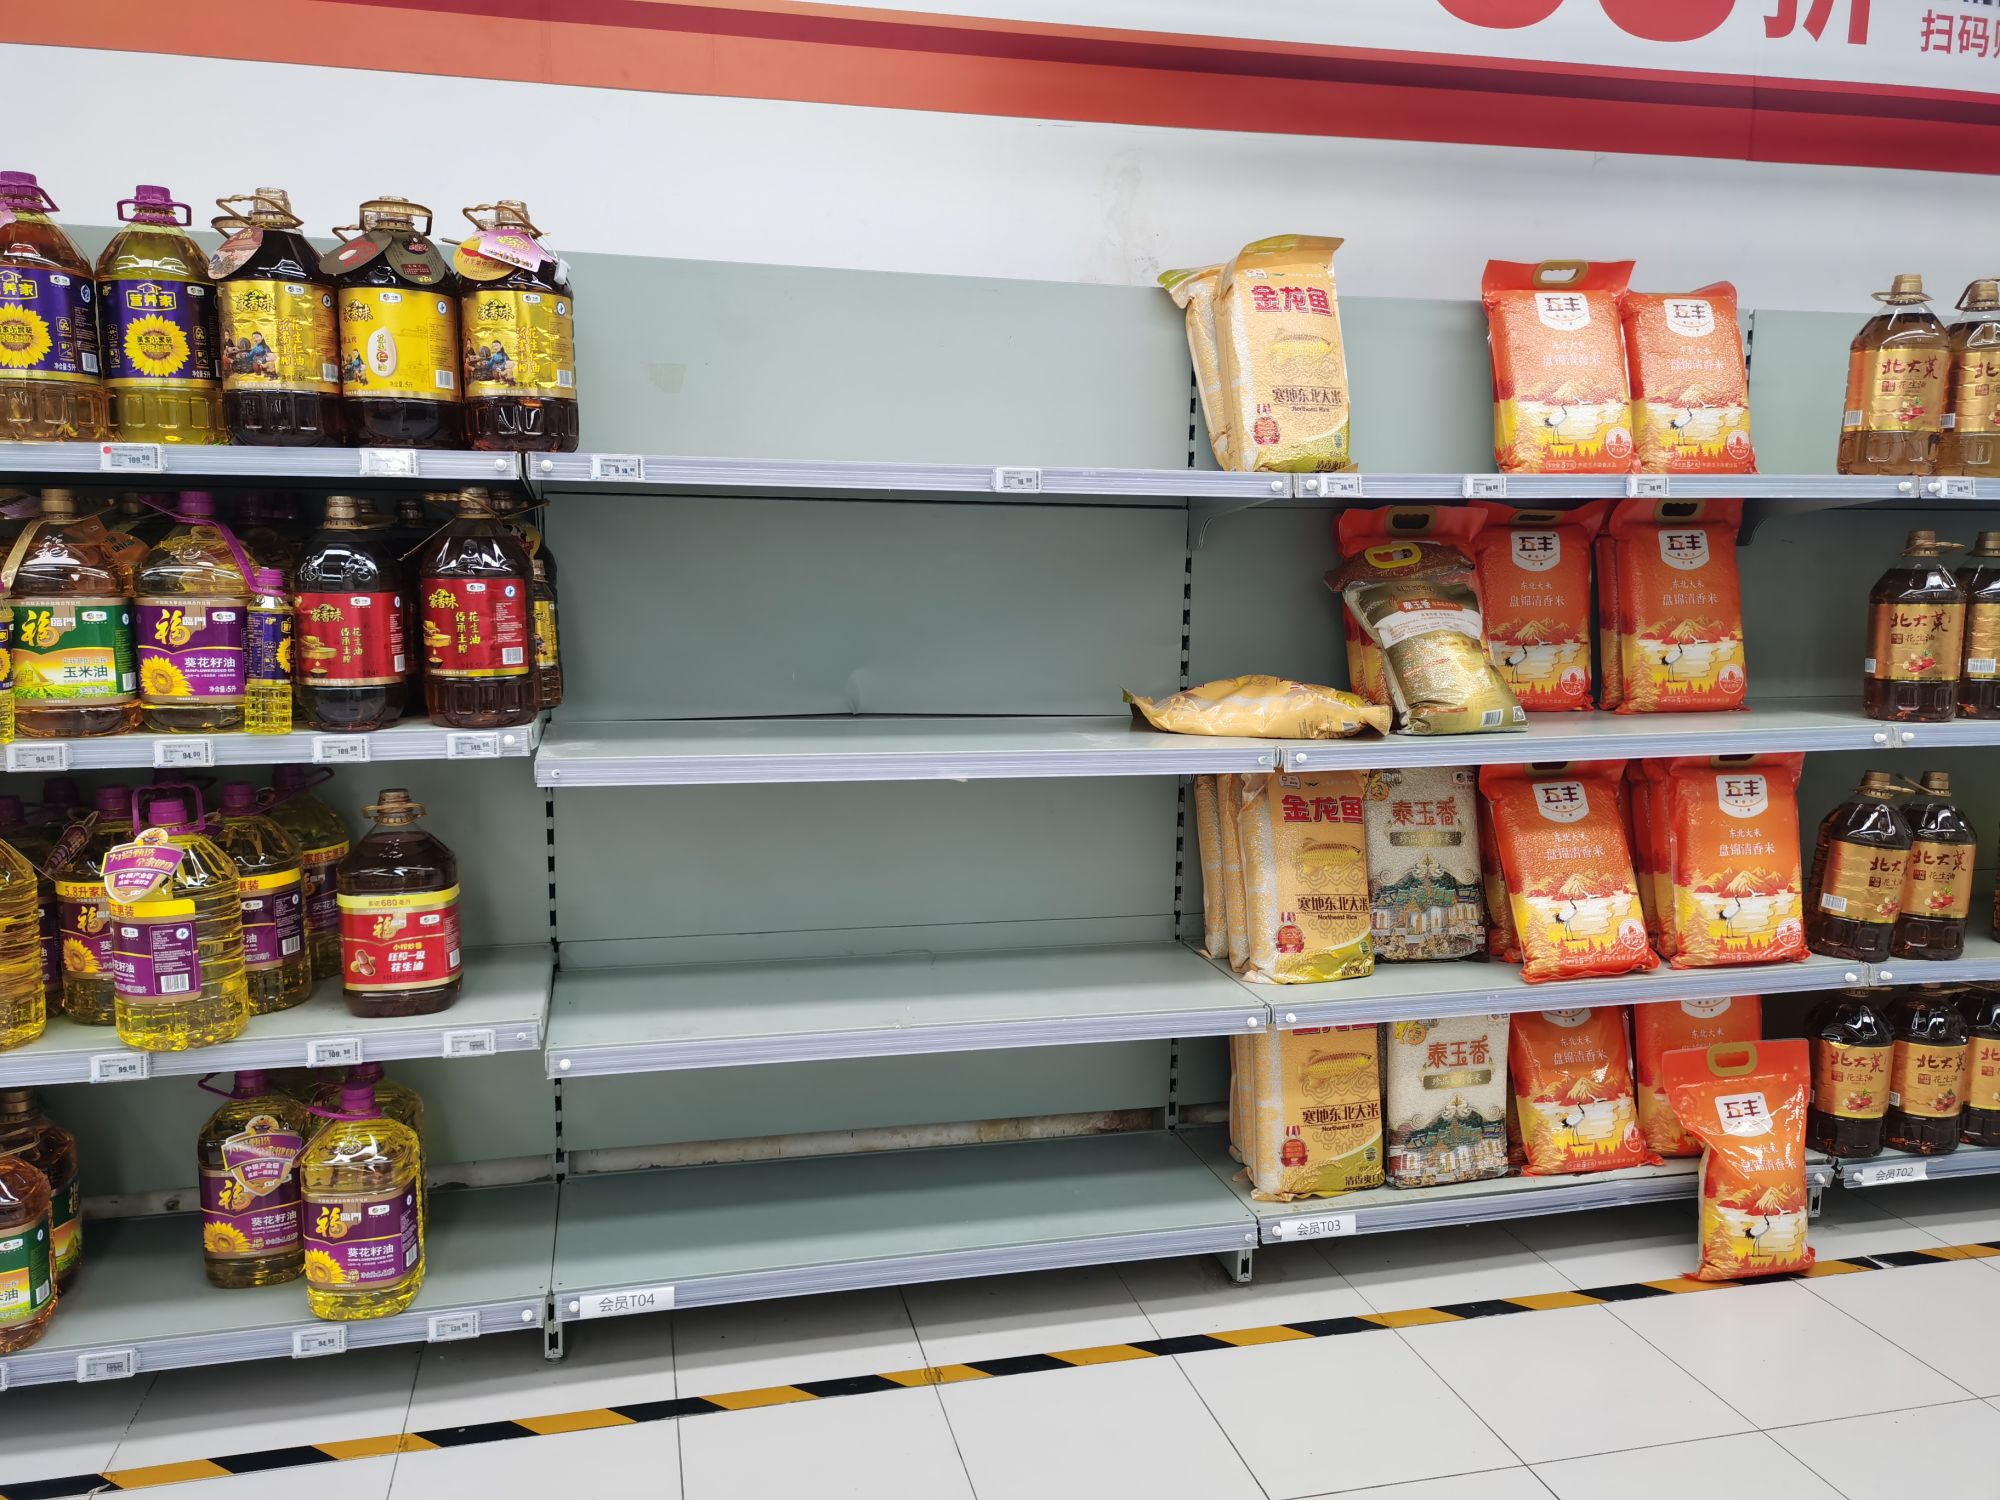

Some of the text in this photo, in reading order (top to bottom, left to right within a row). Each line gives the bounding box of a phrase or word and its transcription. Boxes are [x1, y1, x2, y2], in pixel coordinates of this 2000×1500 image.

[1920, 9, 2000, 58] 扫码
[0, 282, 34, 297] 养家
[1251, 285, 1334, 317] 金龙鱼
[1543, 295, 1582, 314] 五丰
[1672, 302, 1707, 320] 五丰
[1881, 355, 1939, 380] 北大荒
[1518, 534, 1554, 552] 五丰
[1666, 534, 1702, 551] 五丰
[1509, 594, 1566, 608] 盘锦清香米
[1662, 593, 1719, 607] 盘锦清香米
[1889, 609, 1949, 633] 北大荒
[184, 657, 236, 668] 葵花籽油
[63, 665, 108, 679] 玉米油
[1542, 782, 1579, 804] 五丰
[1725, 778, 1761, 798] 五丰
[1281, 794, 1364, 825] 金龙鱼
[1392, 797, 1458, 826] 泰玉香
[1719, 842, 1776, 858] 盘锦清香米
[1870, 856, 1908, 877] 北大
[1912, 849, 1967, 873] 北大荒
[1297, 896, 1369, 912] 寒地东北大米
[390, 961, 424, 973] 花生油
[1427, 1033, 1490, 1069] 泰玉香
[1553, 1048, 1608, 1066] 盘锦清香米
[1830, 1051, 1885, 1074] 北大荒
[1916, 1051, 1967, 1074] 北大荒
[1302, 1103, 1380, 1125] 寒地东北大米
[1723, 1099, 1761, 1119] 五丰
[1321, 1122, 1365, 1133] Northeast Rice
[1875, 1166, 1915, 1182] 会员T02
[251, 1210, 297, 1227] 葵花籽油
[1296, 1219, 1342, 1237] 会员T03
[347, 1243, 395, 1258] 葵花籽油
[599, 1293, 655, 1313] 会员T04
